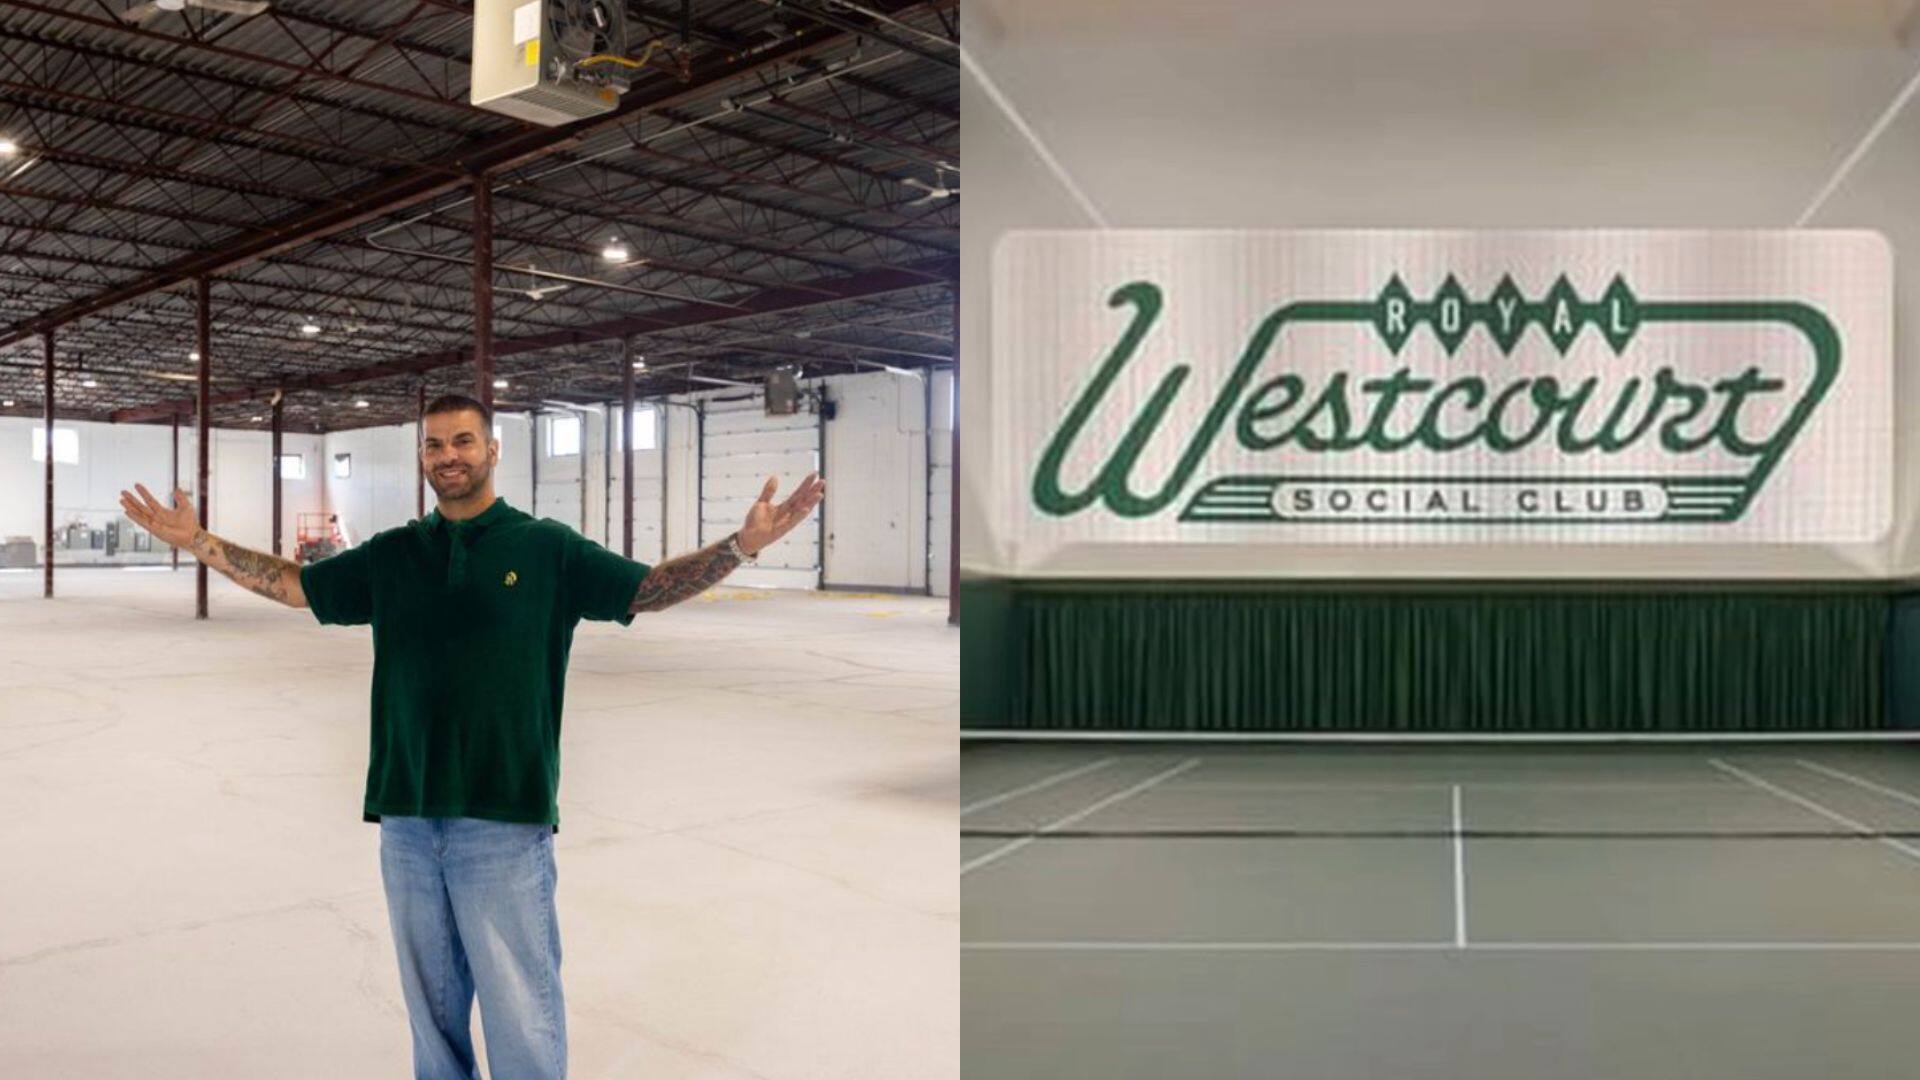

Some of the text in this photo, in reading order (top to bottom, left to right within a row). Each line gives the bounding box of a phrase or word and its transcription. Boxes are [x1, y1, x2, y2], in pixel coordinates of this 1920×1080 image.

[1385, 297, 1631, 335] ROYAL
[1032, 280, 1800, 519] Westcourt
[1293, 489, 1646, 513] SOCIAL CLUB
